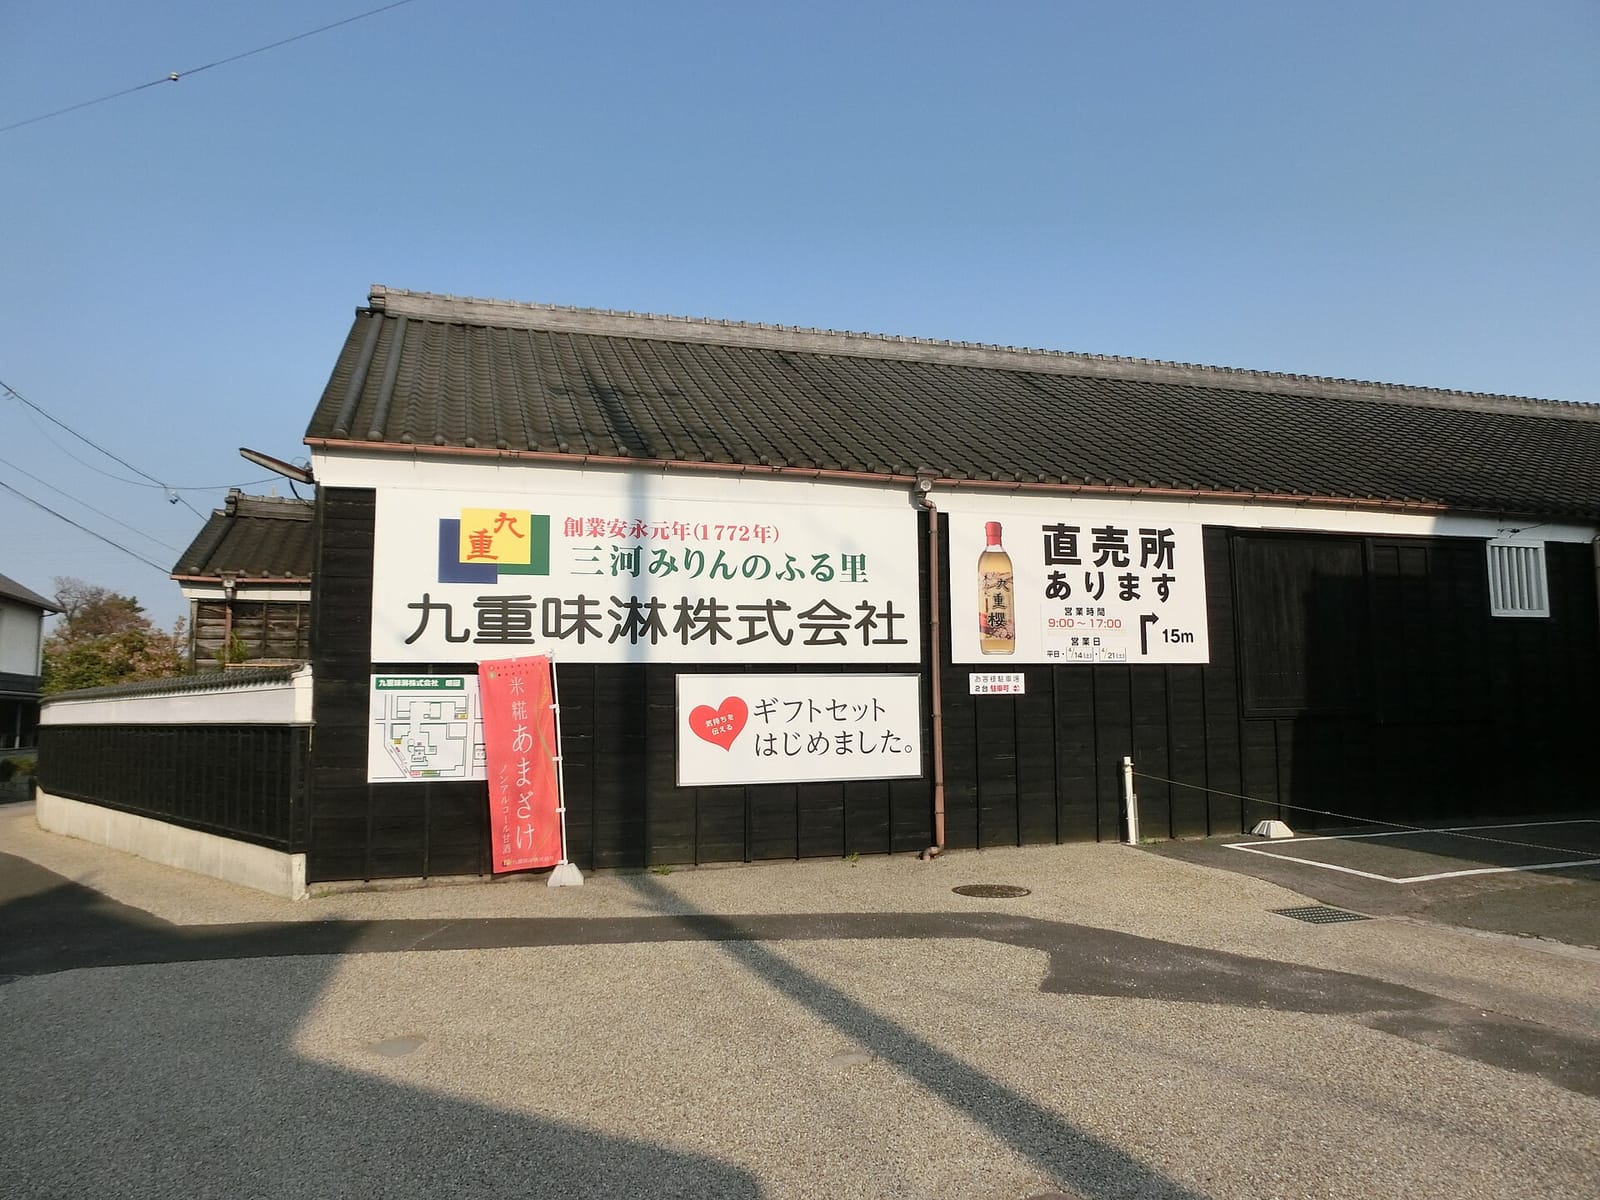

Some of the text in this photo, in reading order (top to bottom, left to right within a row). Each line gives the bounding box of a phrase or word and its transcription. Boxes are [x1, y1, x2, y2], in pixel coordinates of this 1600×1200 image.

[563, 517, 780, 543] 創業安永元年(1772年)
[1042, 523, 1176, 570] 直売所
[570, 545, 869, 583] 三河みりんのふる里
[1045, 570, 1176, 603] あります
[405, 593, 909, 646] 九重味淋株式会社
[1064, 607, 1105, 616] 営業時間
[1071, 637, 1101, 646] 営業日
[1162, 629, 1194, 643] 15m
[753, 697, 886, 724] ギフトセット
[755, 729, 913, 757] はじめました。
